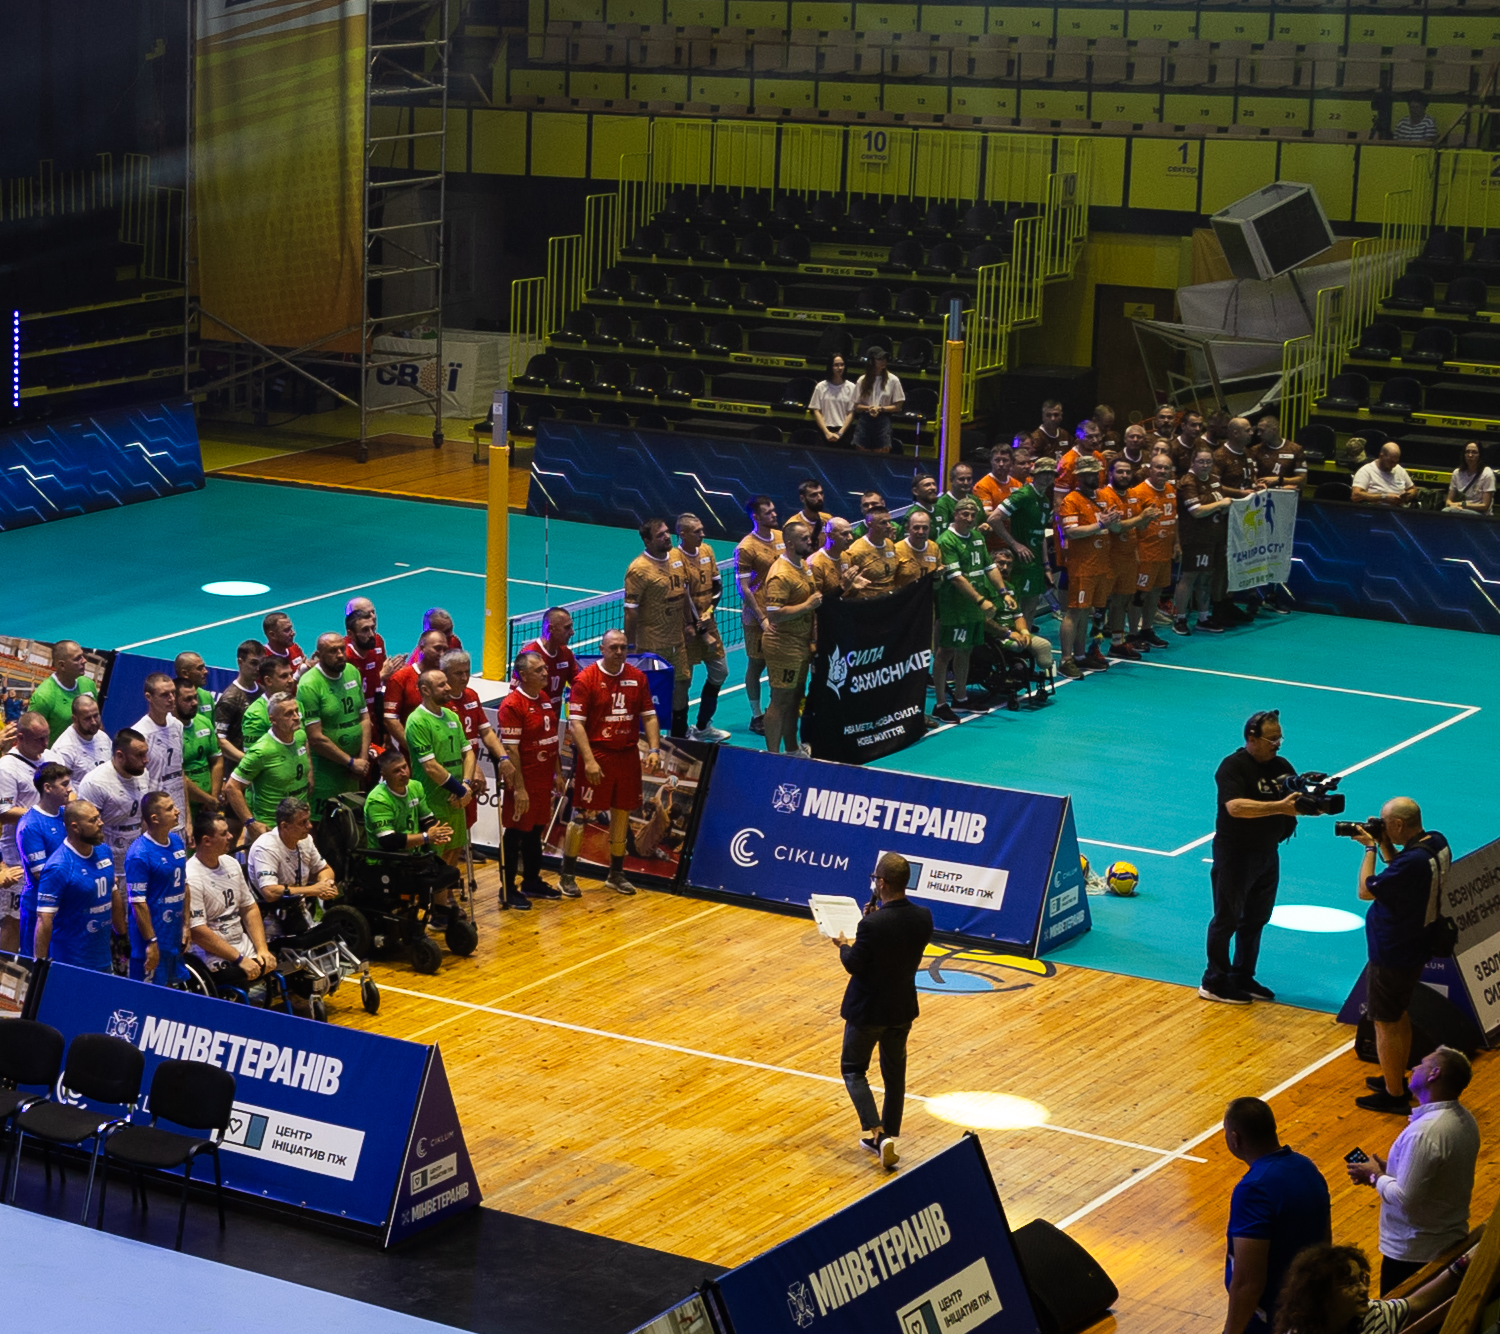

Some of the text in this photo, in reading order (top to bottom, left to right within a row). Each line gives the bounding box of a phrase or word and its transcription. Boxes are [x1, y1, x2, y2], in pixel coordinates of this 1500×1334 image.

[863, 131, 887, 152] 10
[1177, 142, 1188, 164] 1
[970, 552, 980, 566] 14
[1196, 554, 1208, 567] 14
[668, 575, 681, 590] 14
[1023, 579, 1030, 592] 4
[1136, 573, 1149, 587] 12
[1078, 590, 1085, 604] 0
[952, 627, 967, 643] 14
[846, 646, 885, 668] СИЛА
[782, 669, 796, 684] 13
[340, 696, 354, 714] 12
[611, 693, 626, 709] 14
[464, 716, 472, 733] 2
[543, 716, 551, 732] 8
[166, 748, 174, 766] 7
[580, 786, 595, 803] 14
[802, 787, 987, 845] МІНВЕТЕРАНІВ
[773, 845, 850, 871] CIKLUM
[172, 867, 181, 887] 2
[930, 869, 963, 882] ЦЕНТР
[94, 876, 108, 898] 10
[926, 880, 995, 900] ІНІЦІАТИВ ПЖ
[222, 888, 234, 909] 12
[139, 1015, 344, 1096] МІНВЕТЕРАНІВ
[276, 1124, 312, 1141] ЦЕНТР
[272, 1140, 347, 1166] ІНІЦІАТИВ ПЖ
[411, 1182, 469, 1222] МІНВЕТЕРАНІВ
[809, 1201, 951, 1317] МІНВЕТЕРАНІВ
[937, 1289, 963, 1313] ЦЕНТР
[943, 1288, 992, 1329] ІНІЦІАТИВ ПЖ
